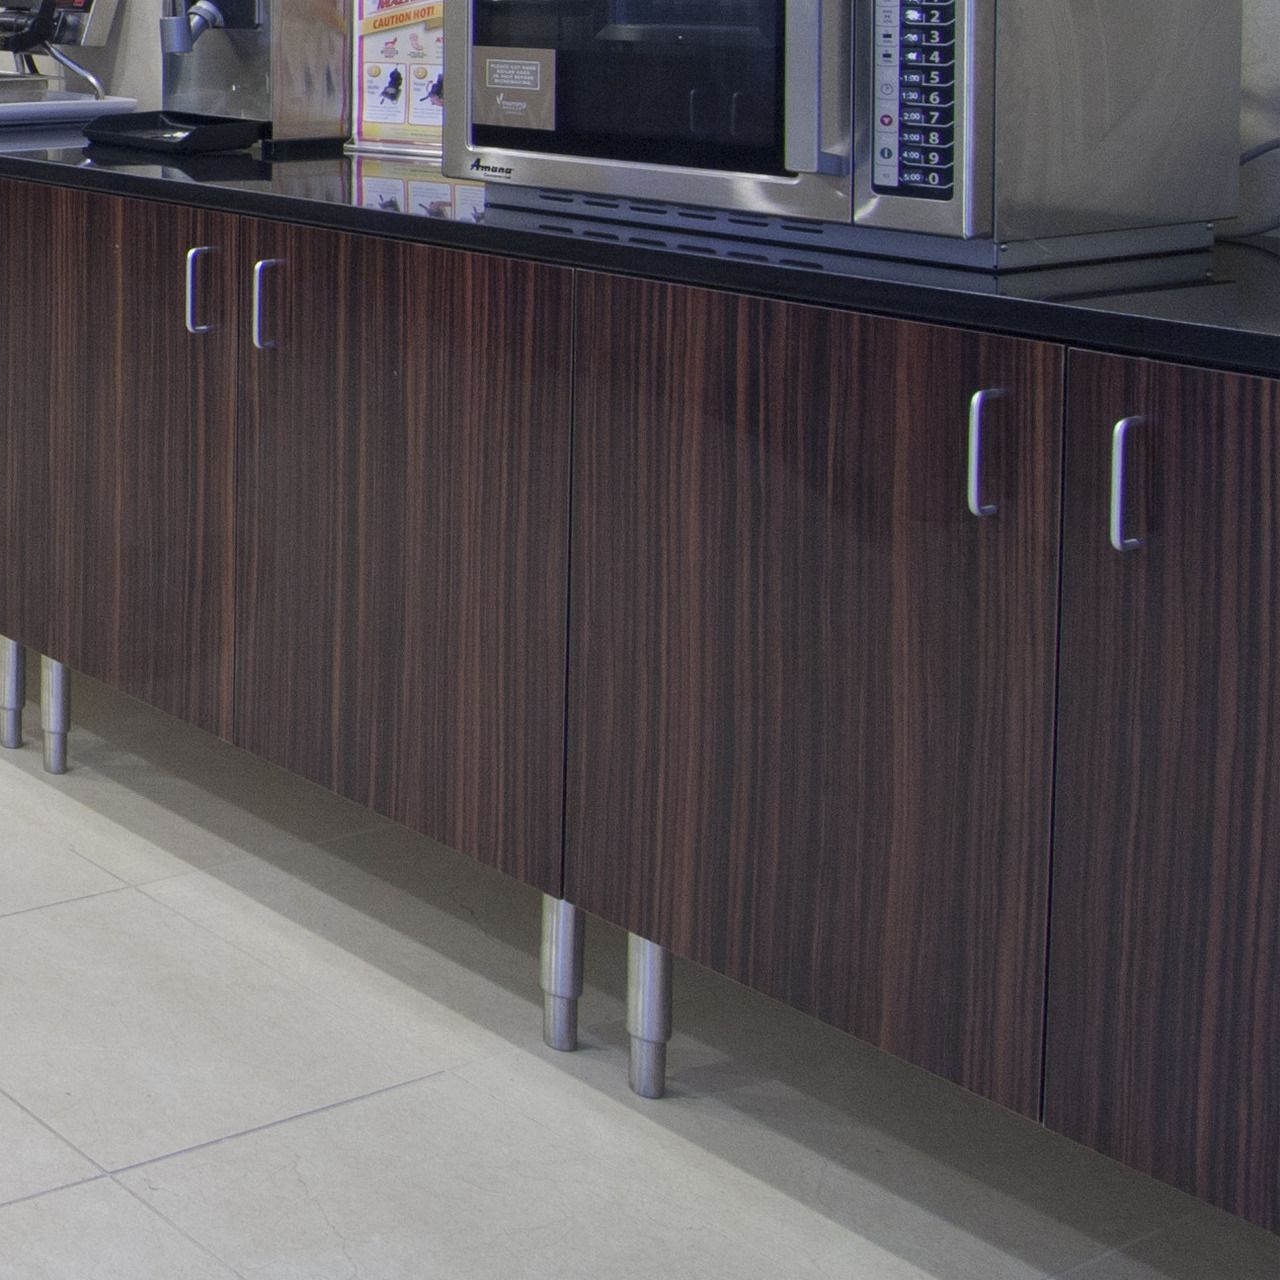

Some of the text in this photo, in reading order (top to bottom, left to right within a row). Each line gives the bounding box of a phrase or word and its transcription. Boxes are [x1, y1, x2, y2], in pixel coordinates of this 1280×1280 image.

[372, 5, 435, 30] CAUTION HOT!
[929, 10, 940, 23] 2
[929, 30, 940, 44] 3
[929, 51, 940, 64] 4
[930, 71, 940, 84] 5
[929, 91, 940, 104] 6
[903, 111, 940, 124] 2:00 7
[903, 132, 939, 144] 3:00 8
[902, 151, 939, 164] 4:00 9
[470, 157, 512, 175] Amana
[903, 173, 920, 181] 5:00
[928, 172, 939, 185] 0
